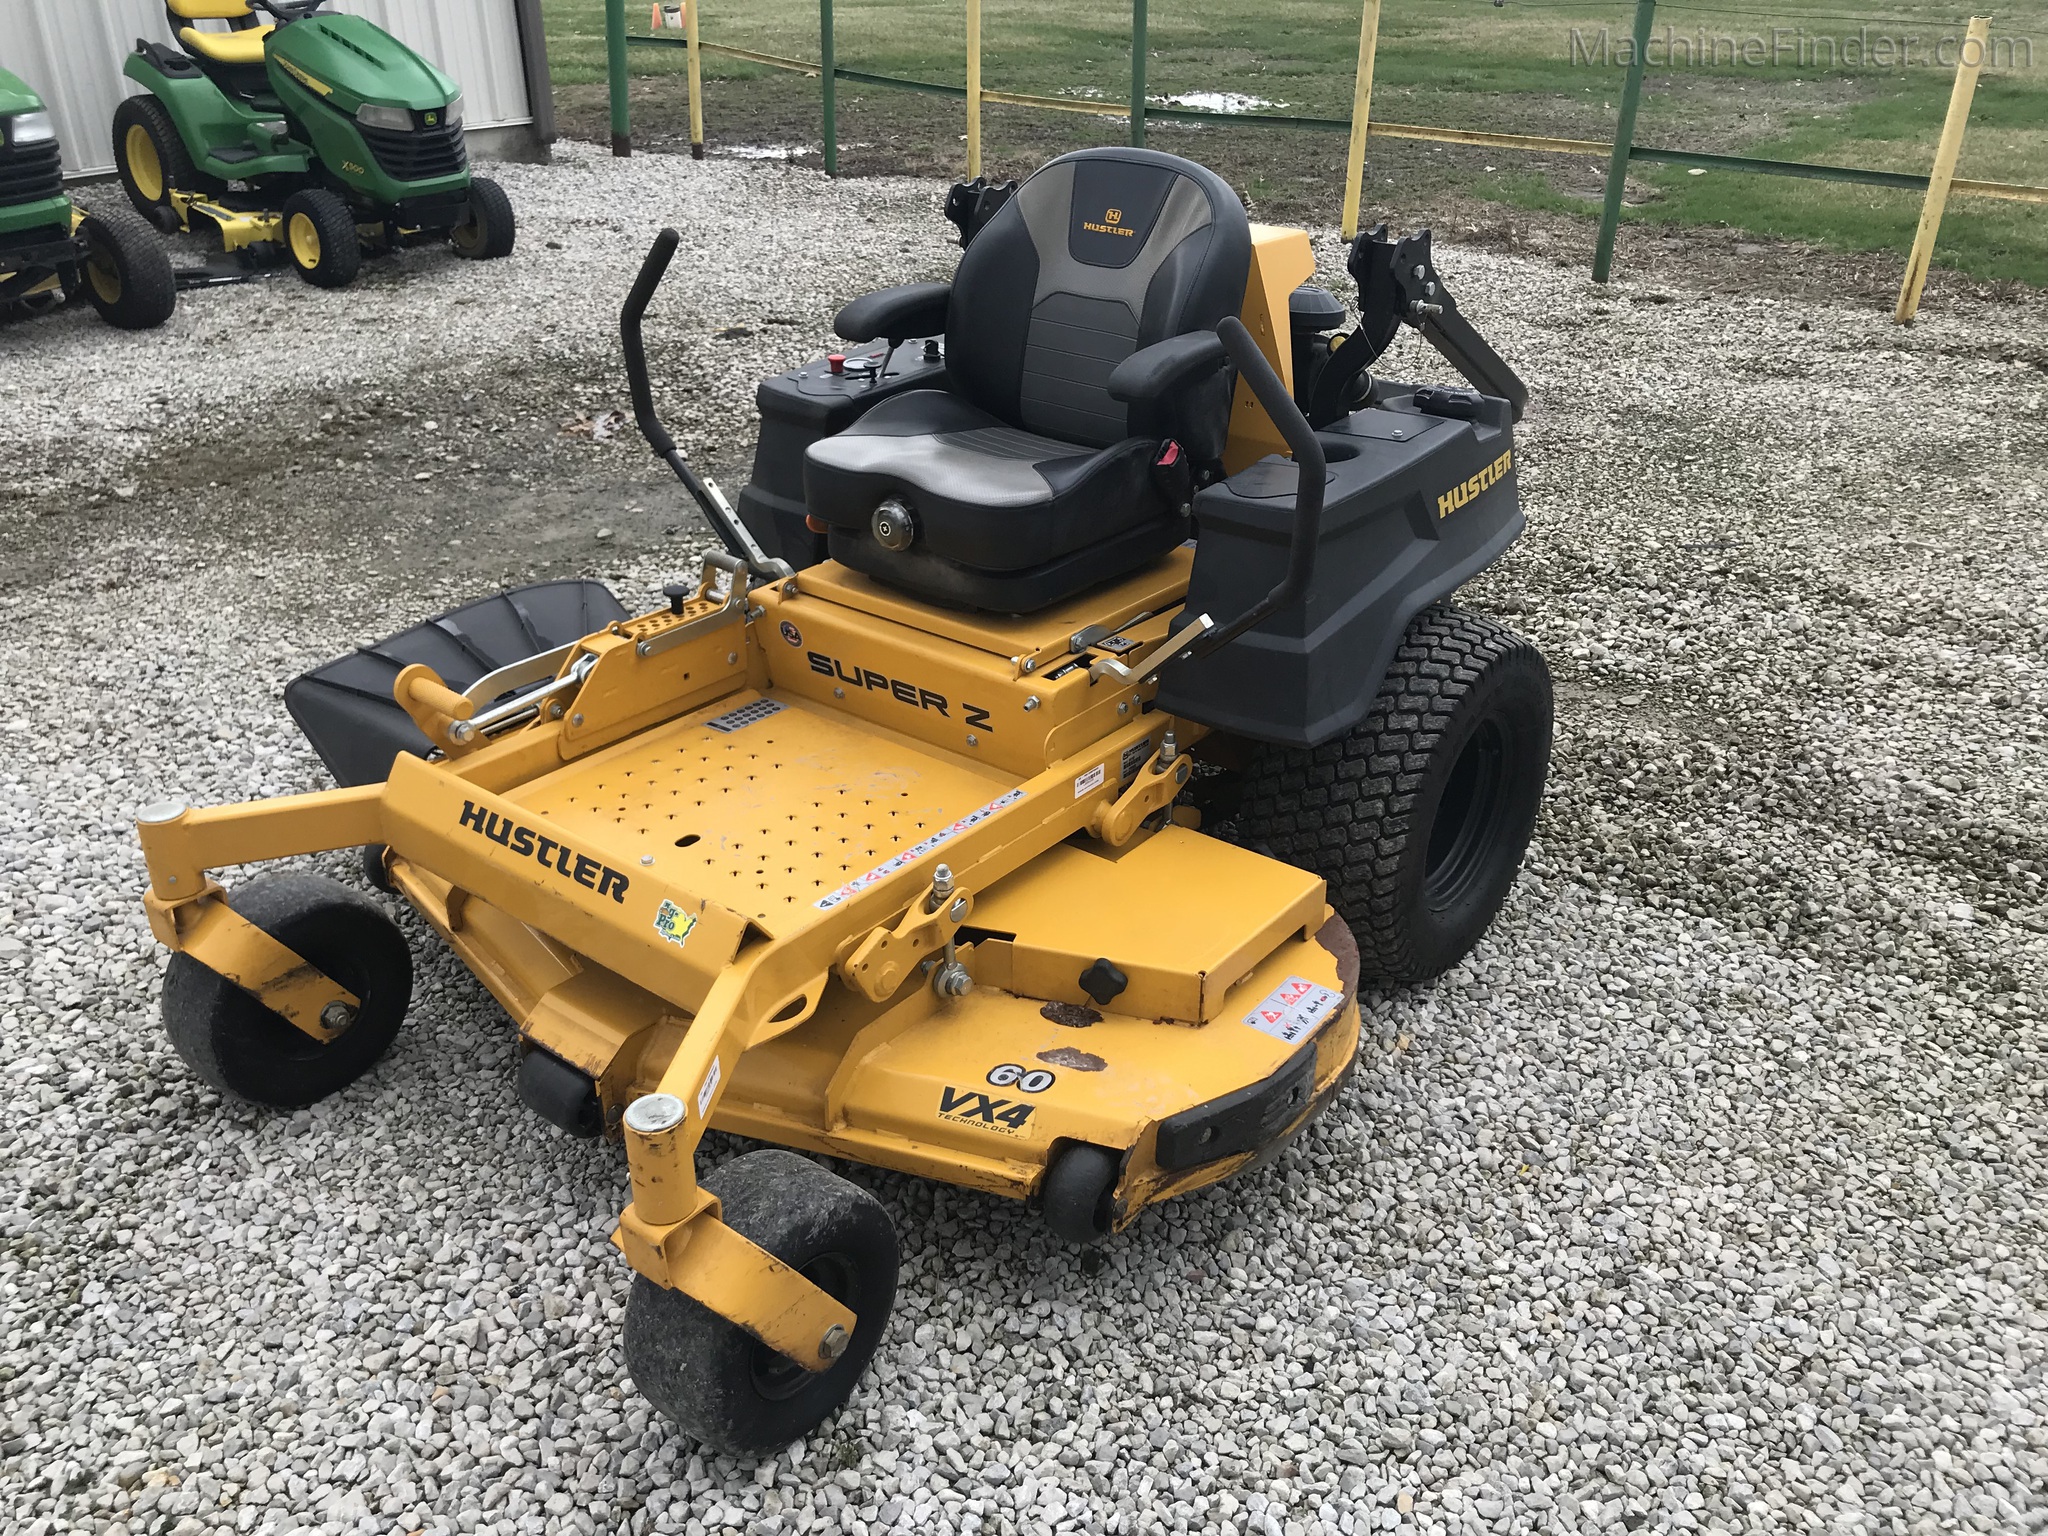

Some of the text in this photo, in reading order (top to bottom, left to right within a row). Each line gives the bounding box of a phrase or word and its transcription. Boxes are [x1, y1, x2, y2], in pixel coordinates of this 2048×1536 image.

[1083, 222, 1134, 237] HUSTLER
[1437, 449, 1512, 519] HUSTLER
[807, 651, 993, 732] SUPER Z
[459, 800, 630, 904] HUSTLER
[986, 1063, 1056, 1093] 60
[938, 1112, 1015, 1135] TECHNOLOGY
[940, 1086, 1036, 1129] VX4
